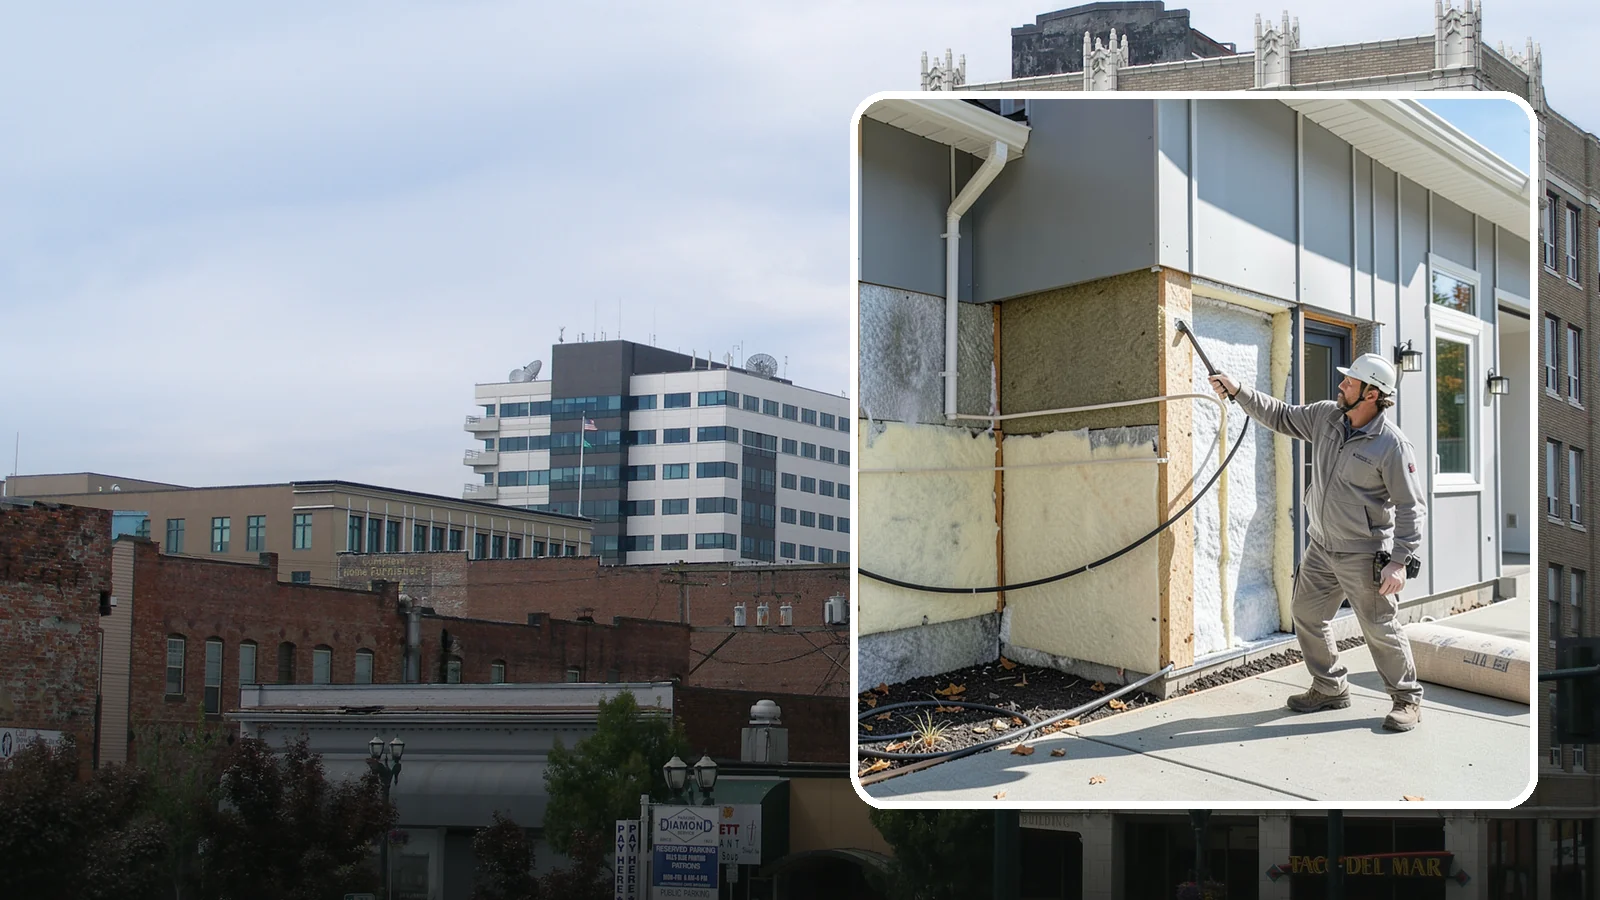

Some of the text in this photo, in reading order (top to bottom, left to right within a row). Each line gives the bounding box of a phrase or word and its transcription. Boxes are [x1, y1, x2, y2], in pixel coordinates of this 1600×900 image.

[343, 566, 427, 577] Home Furnishers
[660, 818, 713, 832] DIAMOND
[1022, 815, 1069, 828] BUILDING
[656, 845, 716, 854] RESERVED PARKING
[616, 825, 625, 893] PAY HERE
[628, 825, 636, 893] PAY HERE
[721, 851, 738, 862] Soup
[671, 862, 701, 870] PATRONS
[1346, 856, 1385, 875] DEL
[1392, 857, 1442, 877] MAR
[660, 889, 710, 899] PUBLIC PARKING
